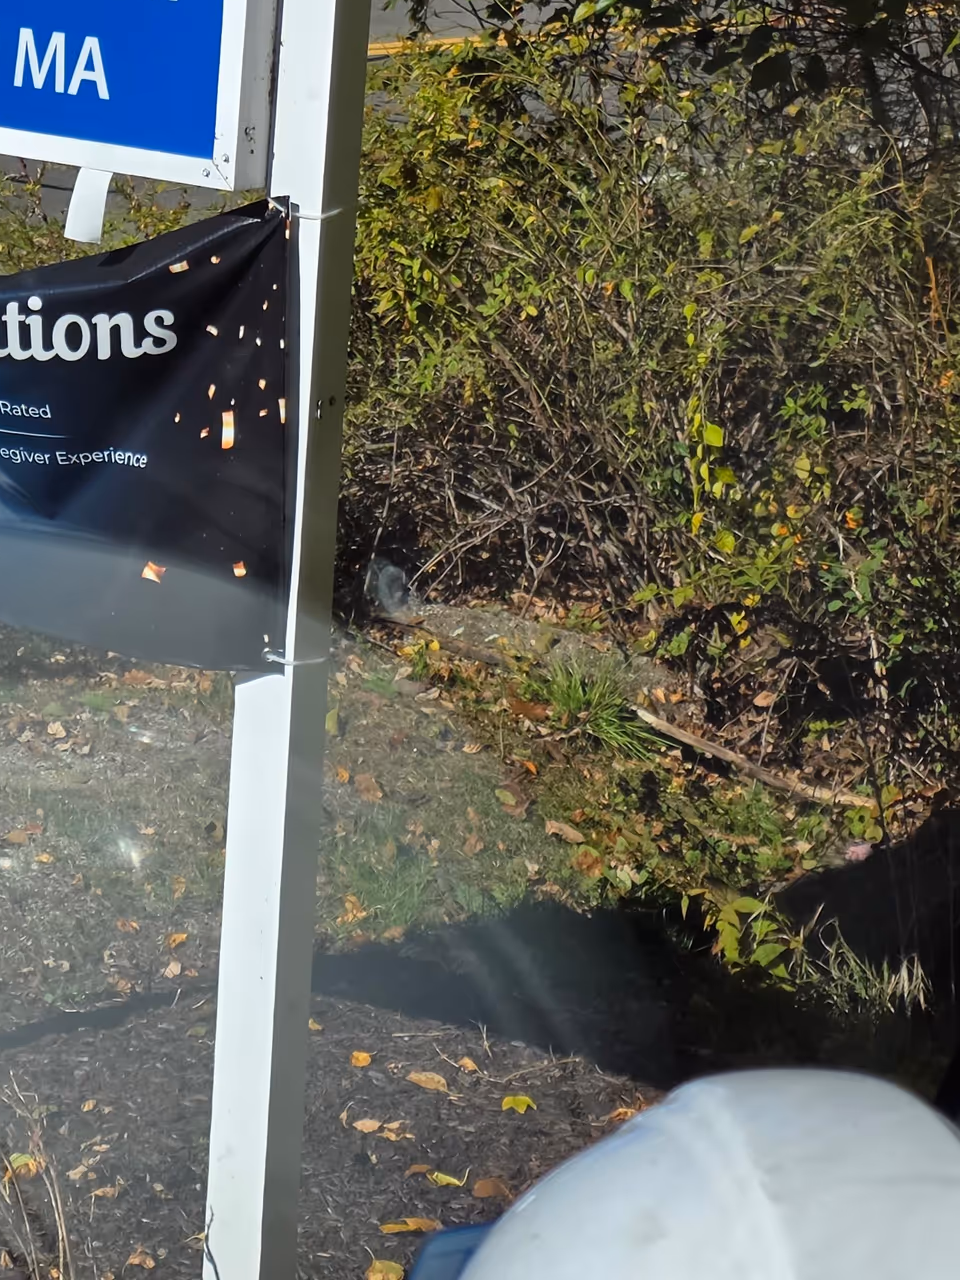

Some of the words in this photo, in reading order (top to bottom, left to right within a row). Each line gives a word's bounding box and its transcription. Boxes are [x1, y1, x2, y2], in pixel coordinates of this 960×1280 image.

[13, 27, 110, 100] MA
[0, 400, 51, 419] Rated
[56, 447, 148, 468] Experience
